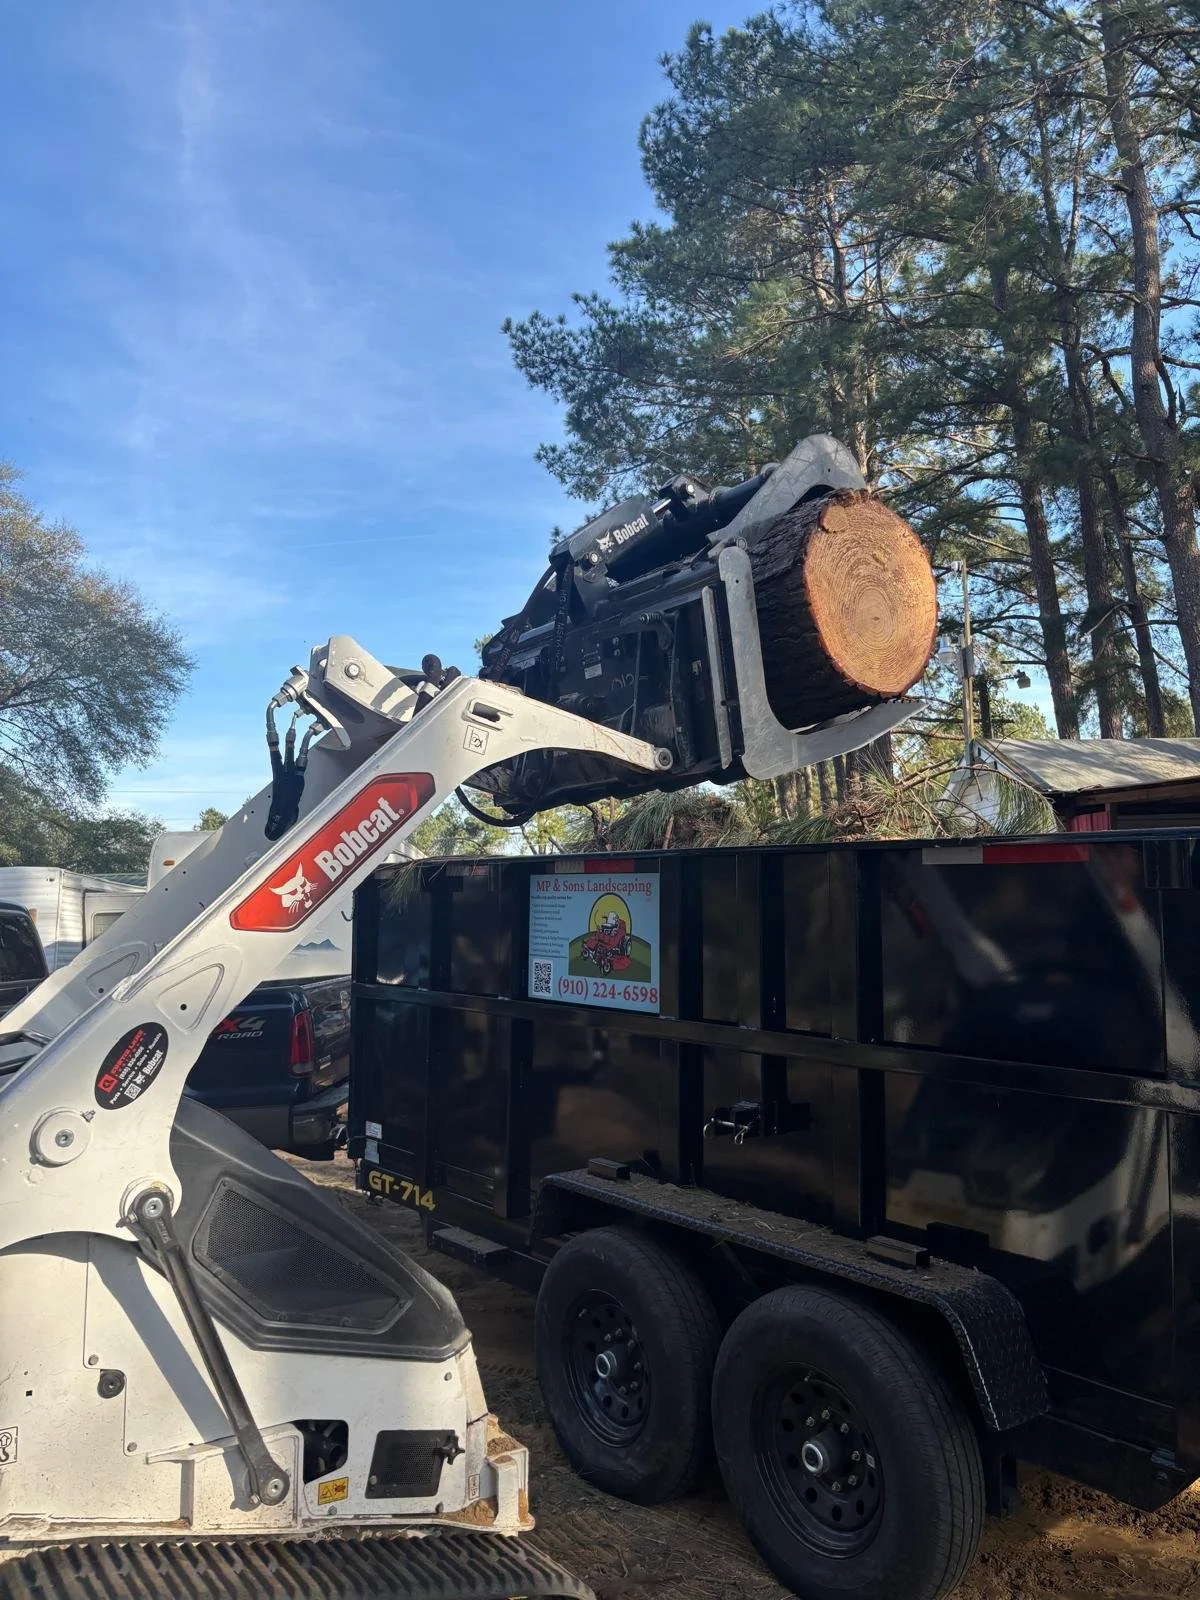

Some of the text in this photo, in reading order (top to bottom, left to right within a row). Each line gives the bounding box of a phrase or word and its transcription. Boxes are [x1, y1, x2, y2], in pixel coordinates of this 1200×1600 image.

[612, 513, 649, 545] Bobcat
[313, 796, 401, 882] Bobcat
[536, 878, 652, 896] MP & Sons Landscaping
[558, 976, 658, 1004] (910) 224-6598
[215, 1016, 266, 1032] X4
[217, 1030, 264, 1040] ROAD
[142, 1049, 164, 1075] Bobcat
[121, 1070, 136, 1088] Service
[368, 1170, 436, 1211] GT-714
